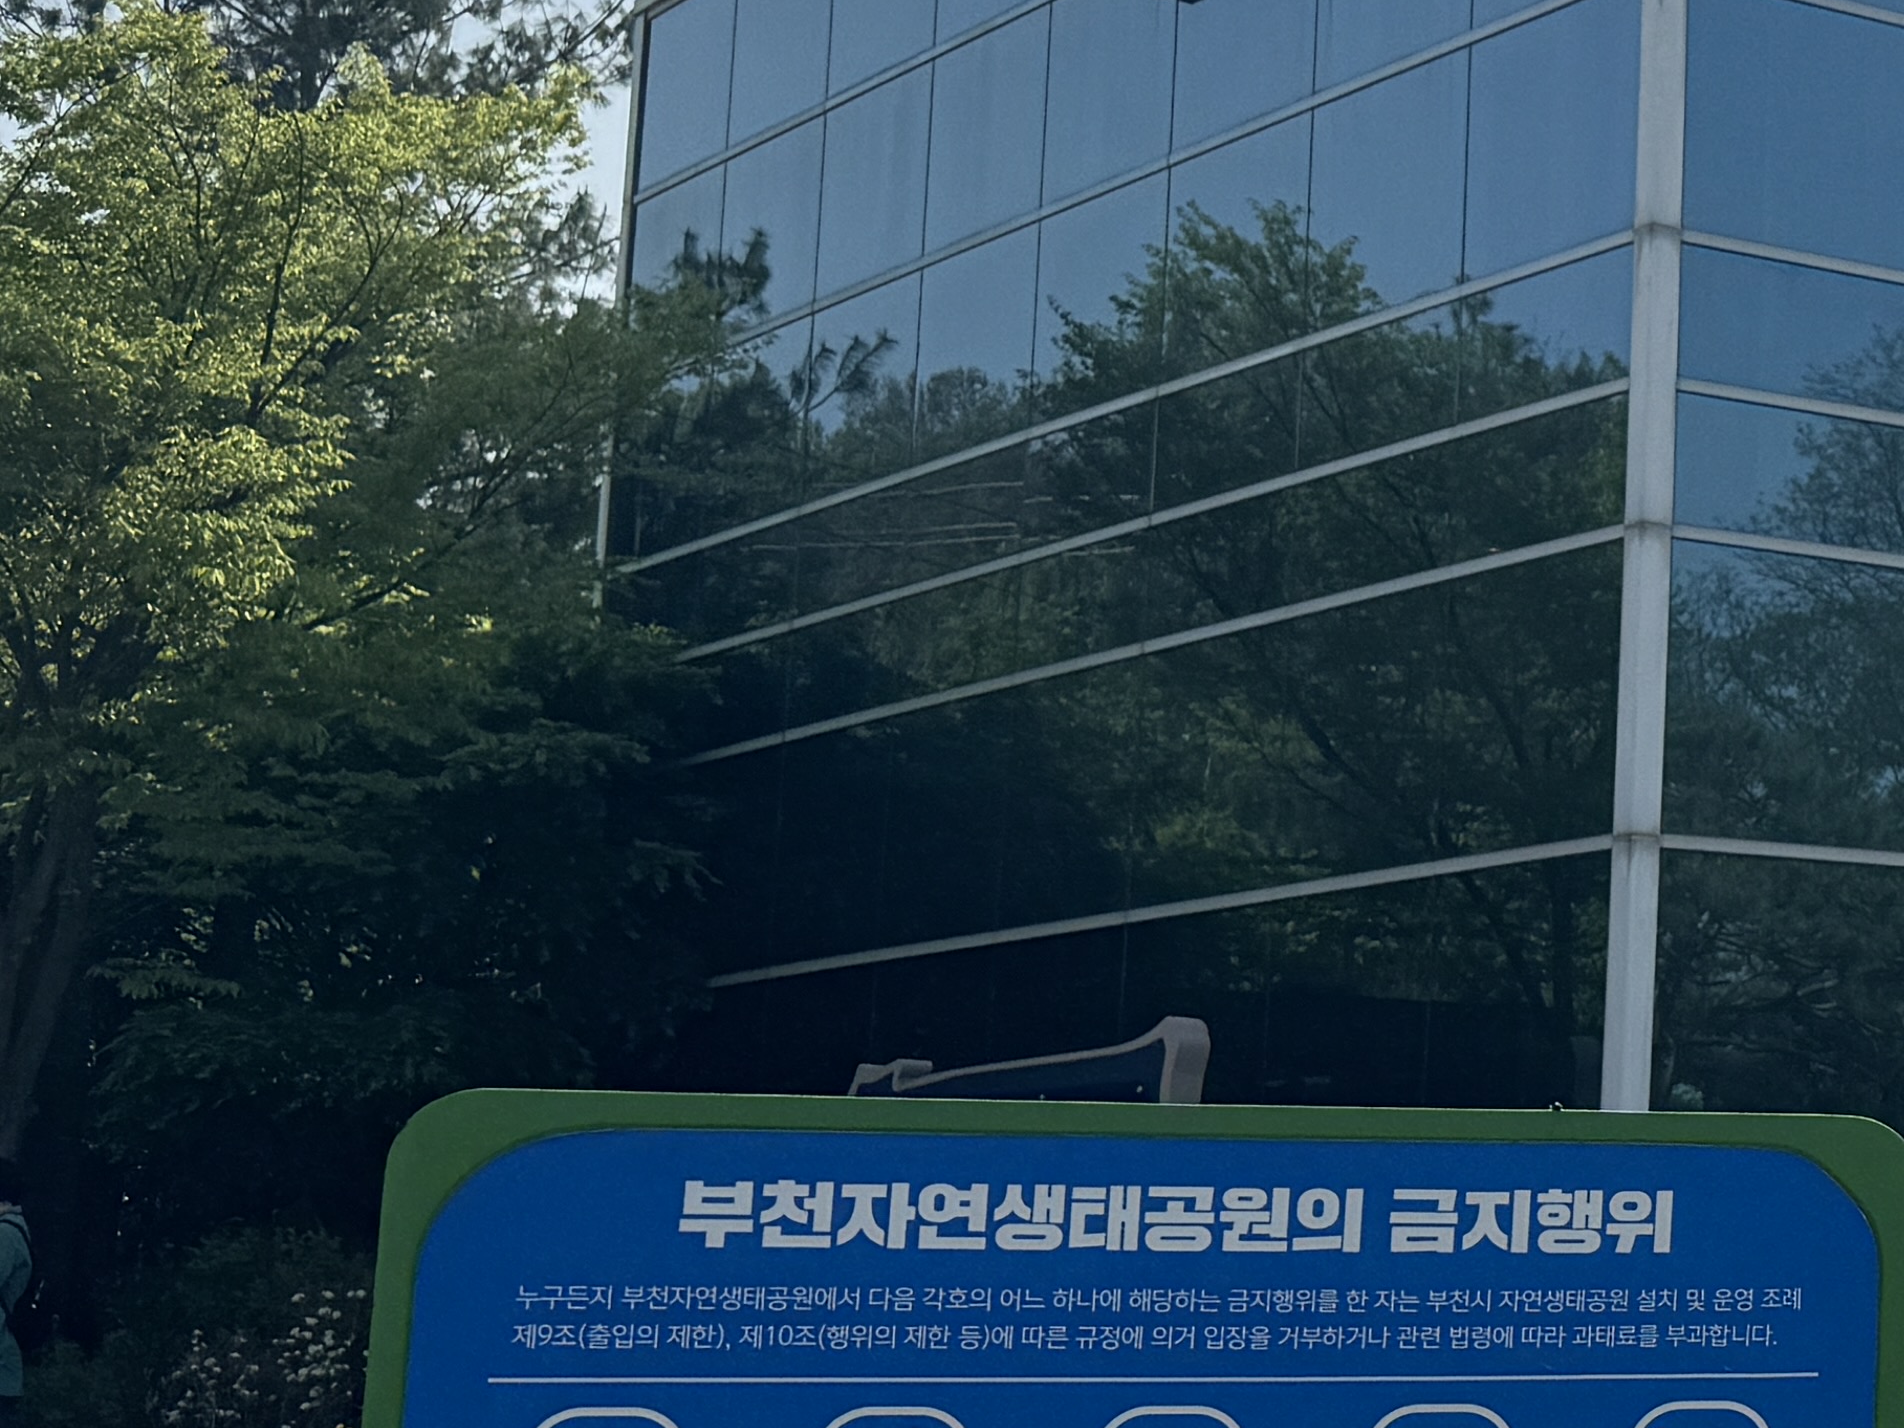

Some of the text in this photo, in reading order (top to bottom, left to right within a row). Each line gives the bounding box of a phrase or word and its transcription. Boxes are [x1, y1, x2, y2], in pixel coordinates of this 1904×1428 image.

[679, 1180, 1673, 1253] 부천자연생태공원의 금지행위
[516, 1286, 1801, 1312] 누구든지 부천자연생태공원에서 다음 각호의 어느 하나에 해당하는 금지행위를 한 자는 부천시 자연생태공원 설치 및 운영 조례
[512, 1324, 1777, 1350] 제9조(출입의 제한), 제10조(행위의 제한 등)에 따른 규정에 의거 입장을 거부하거나 관련 법령에 따라 과태료를 부과합니다.
